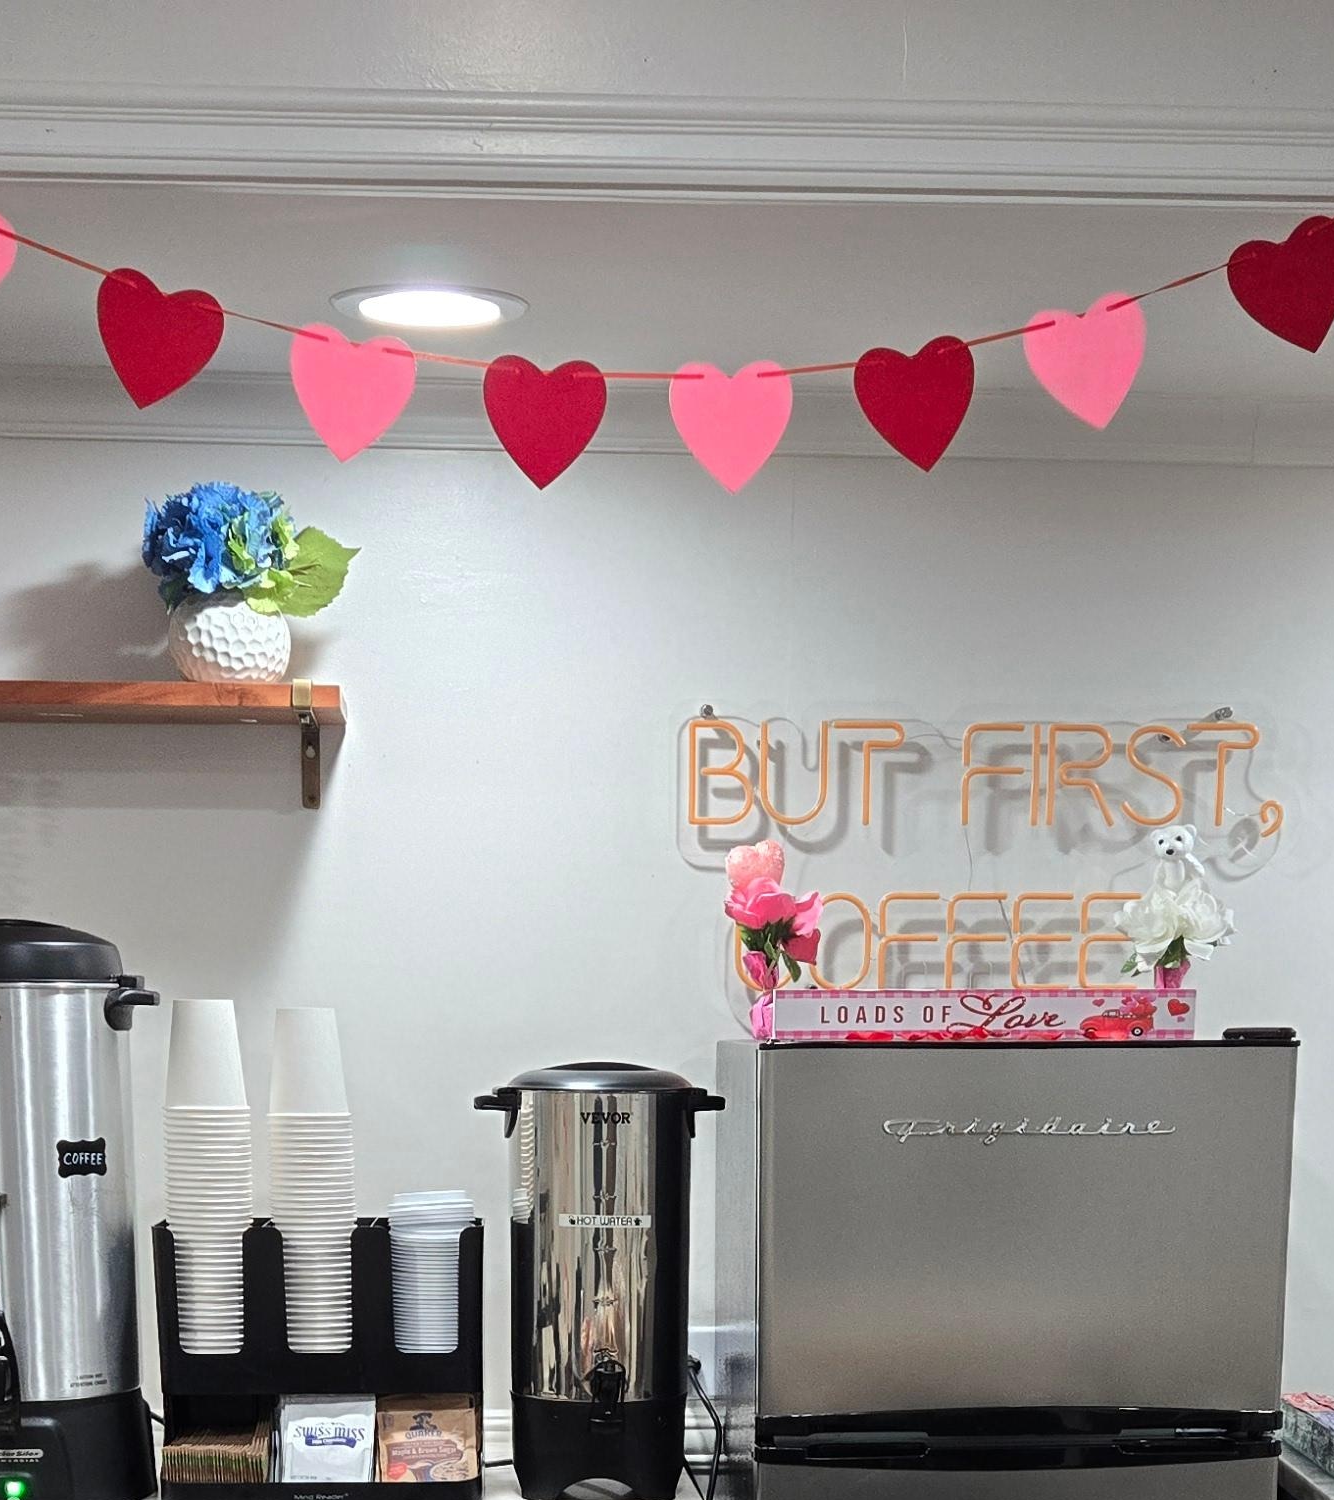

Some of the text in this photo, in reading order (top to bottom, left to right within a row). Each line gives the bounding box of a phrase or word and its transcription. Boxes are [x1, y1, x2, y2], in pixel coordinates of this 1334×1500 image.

[688, 719, 1283, 838] BUT FIRST,
[819, 992, 1066, 1032] LOADS OF Love
[580, 1112, 631, 1125] VEVOR
[882, 1115, 1178, 1146] Frigidaire
[63, 1152, 104, 1165] COFFEE
[577, 1216, 633, 1226] HOT WATER
